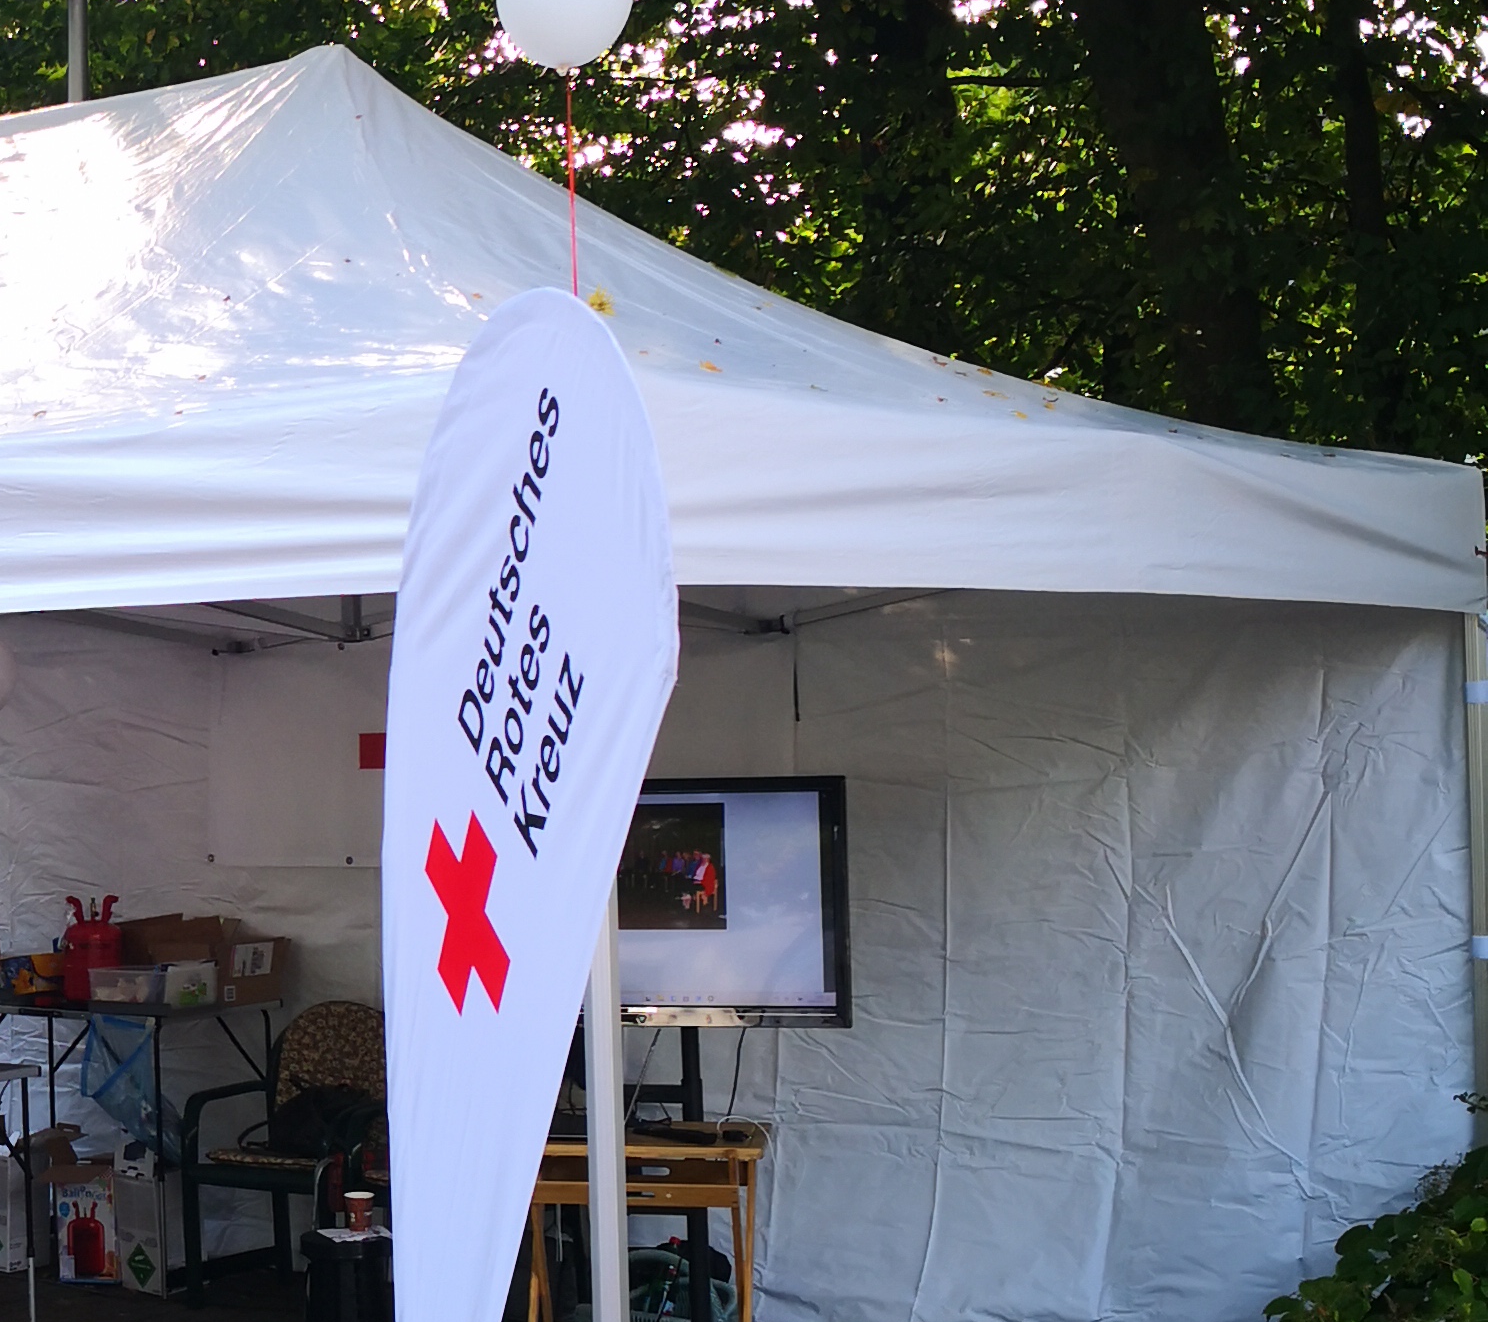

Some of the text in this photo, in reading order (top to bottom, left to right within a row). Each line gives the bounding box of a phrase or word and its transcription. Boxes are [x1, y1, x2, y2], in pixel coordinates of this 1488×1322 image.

[457, 387, 560, 755] Deutsches
[484, 603, 551, 807] Rotes
[513, 651, 585, 861] Kreuz
